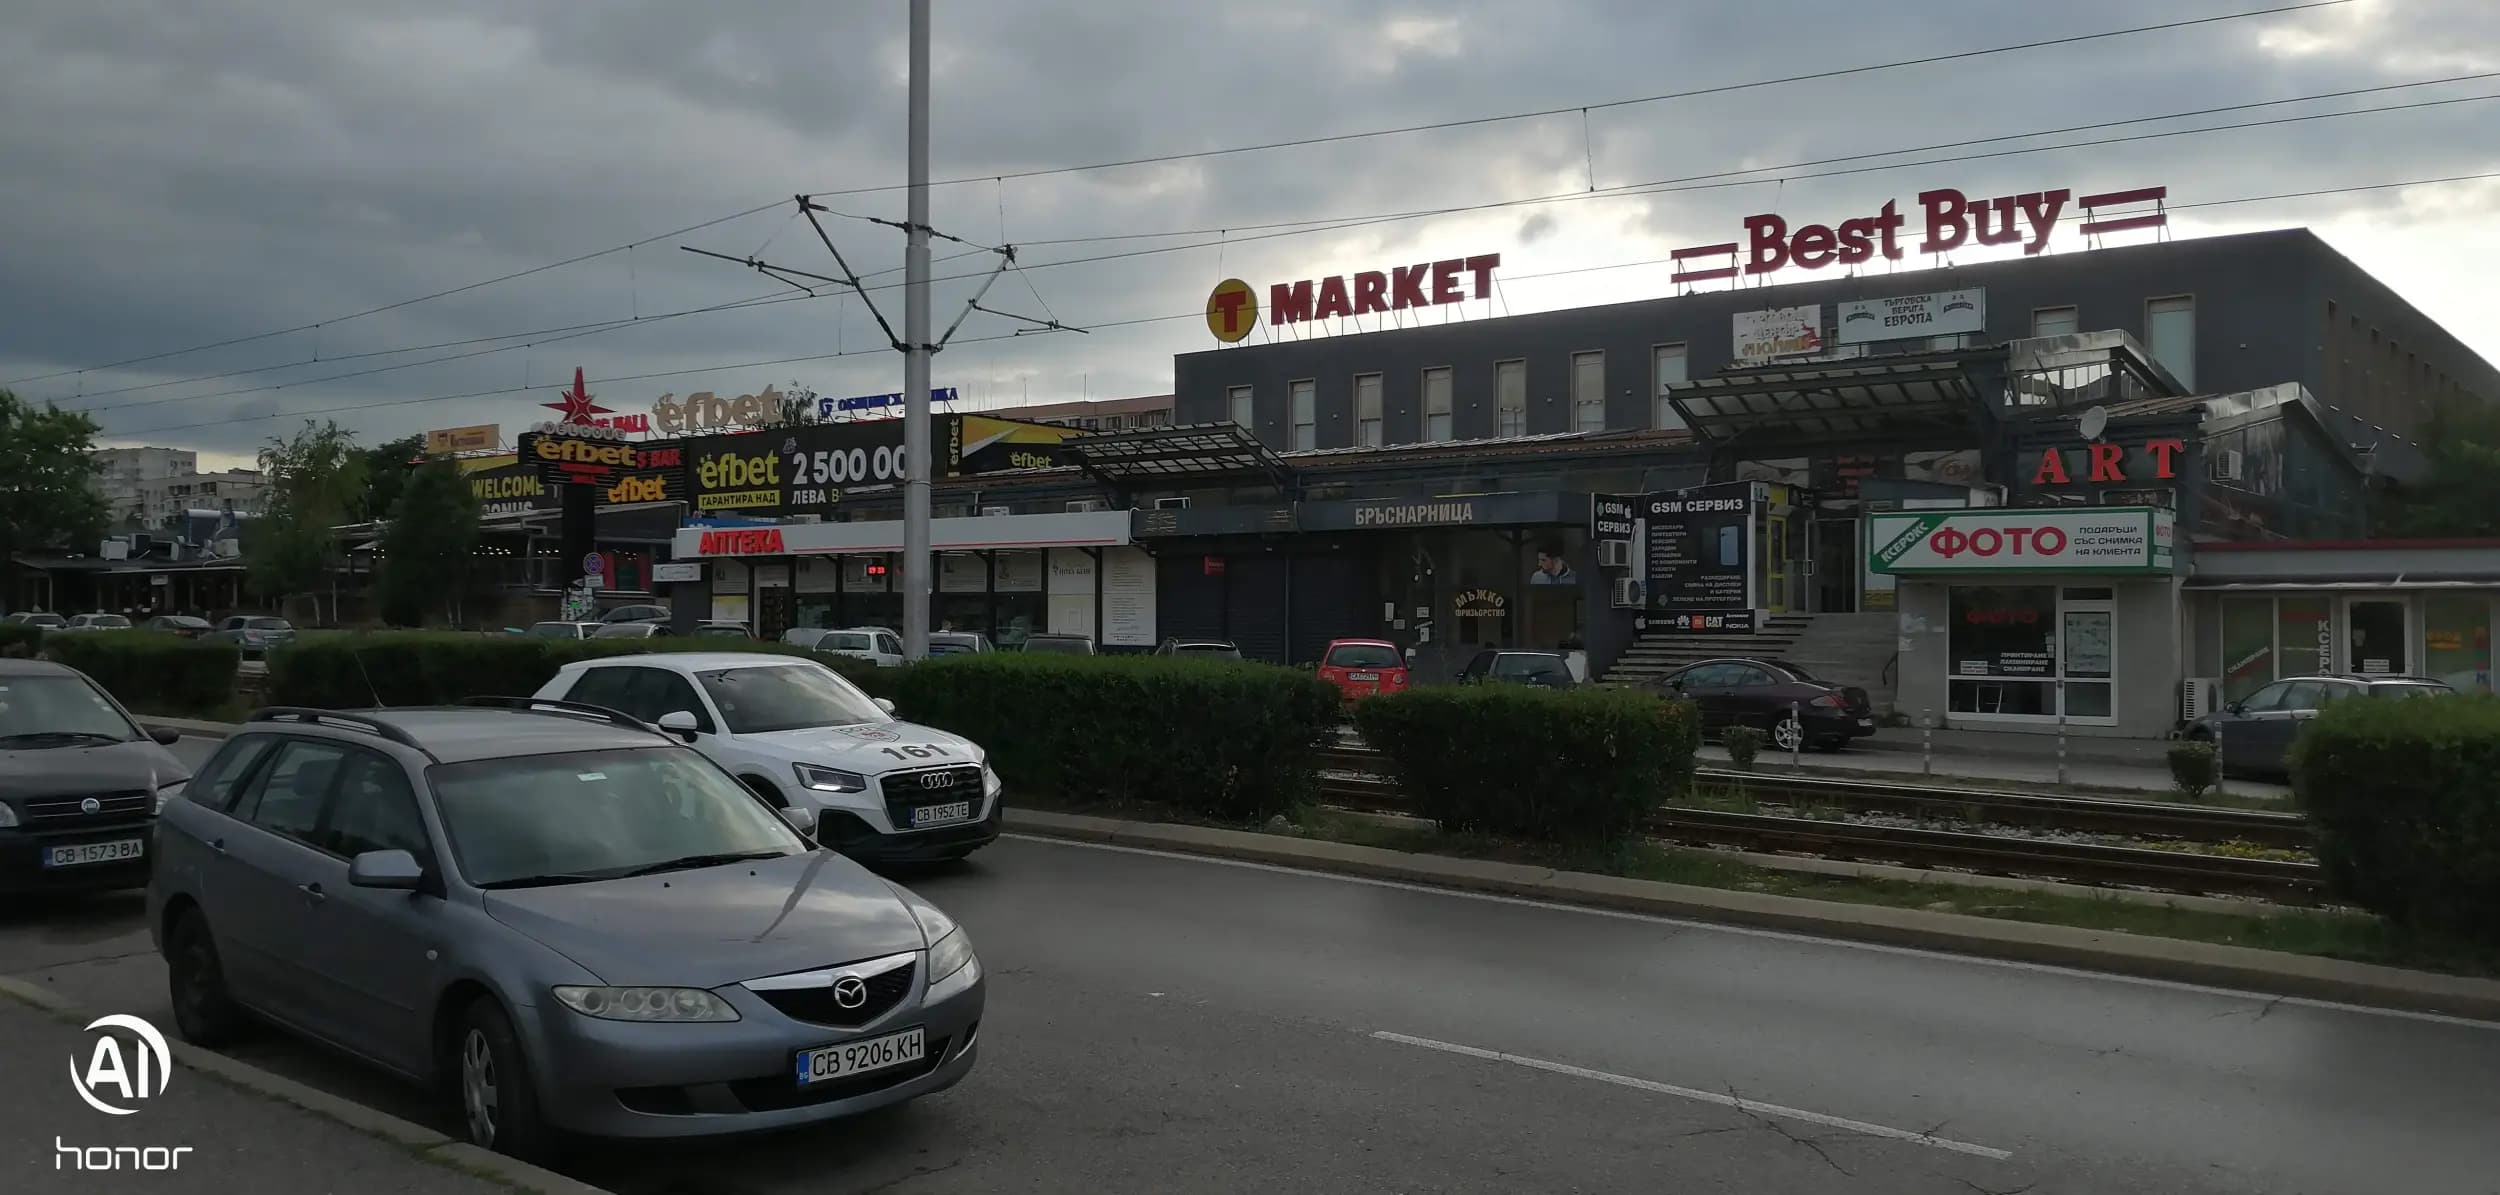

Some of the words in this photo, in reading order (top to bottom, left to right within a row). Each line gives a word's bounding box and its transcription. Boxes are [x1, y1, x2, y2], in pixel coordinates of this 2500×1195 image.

[1743, 198, 1905, 275] Best
[1918, 187, 2070, 256] Buy
[1215, 290, 1246, 333] T
[1270, 253, 1501, 325] MARKET
[1884, 312, 1933, 327] ЕВРОПА
[654, 384, 783, 433] efbet
[544, 421, 625, 441] WELCOME
[536, 438, 637, 466] efbet
[1010, 452, 1052, 468] efbet
[698, 448, 779, 489] efbet
[793, 452, 808, 485] 2
[813, 447, 867, 484] 500
[873, 444, 905, 480] 00
[472, 474, 544, 499] WELCOME
[608, 474, 667, 503] efbet
[702, 494, 753, 507] ГАРАНТИРА
[756, 492, 776, 504] НАД
[792, 489, 827, 505] ЛЕВА
[1651, 501, 1682, 514] GSM
[1686, 498, 1744, 513] СЕРВИЗ
[1355, 502, 1473, 525] БРЪСНАРНИЦА
[1605, 502, 1624, 515] GSM
[1598, 520, 1631, 534] СЕРВИЗ
[2079, 526, 2138, 535] ПОДАРЪЦИ
[2156, 524, 2171, 538] ФОТО
[699, 529, 784, 555] АПТЕКА
[1880, 521, 1930, 563] КСЕРОКС
[1929, 526, 2068, 559] ФОТО
[2074, 537, 2096, 545] СЪС
[2098, 537, 2143, 545] СНИМКА
[2075, 548, 2090, 556] НА
[2093, 547, 2141, 556] КЛИЕНТА
[1455, 588, 1504, 608] МЪЖКО
[1706, 616, 1724, 628] CAT
[2318, 620, 2330, 677] КСЕРО
[880, 743, 950, 760] 161
[917, 808, 930, 822] CB
[933, 806, 954, 820] 1952
[957, 803, 968, 816] TE
[54, 848, 76, 864] CB
[81, 844, 117, 861] 1573
[120, 842, 140, 857] BA
[813, 1051, 840, 1077] CB
[845, 1040, 893, 1071] 9206
[897, 1032, 921, 1060] KH
